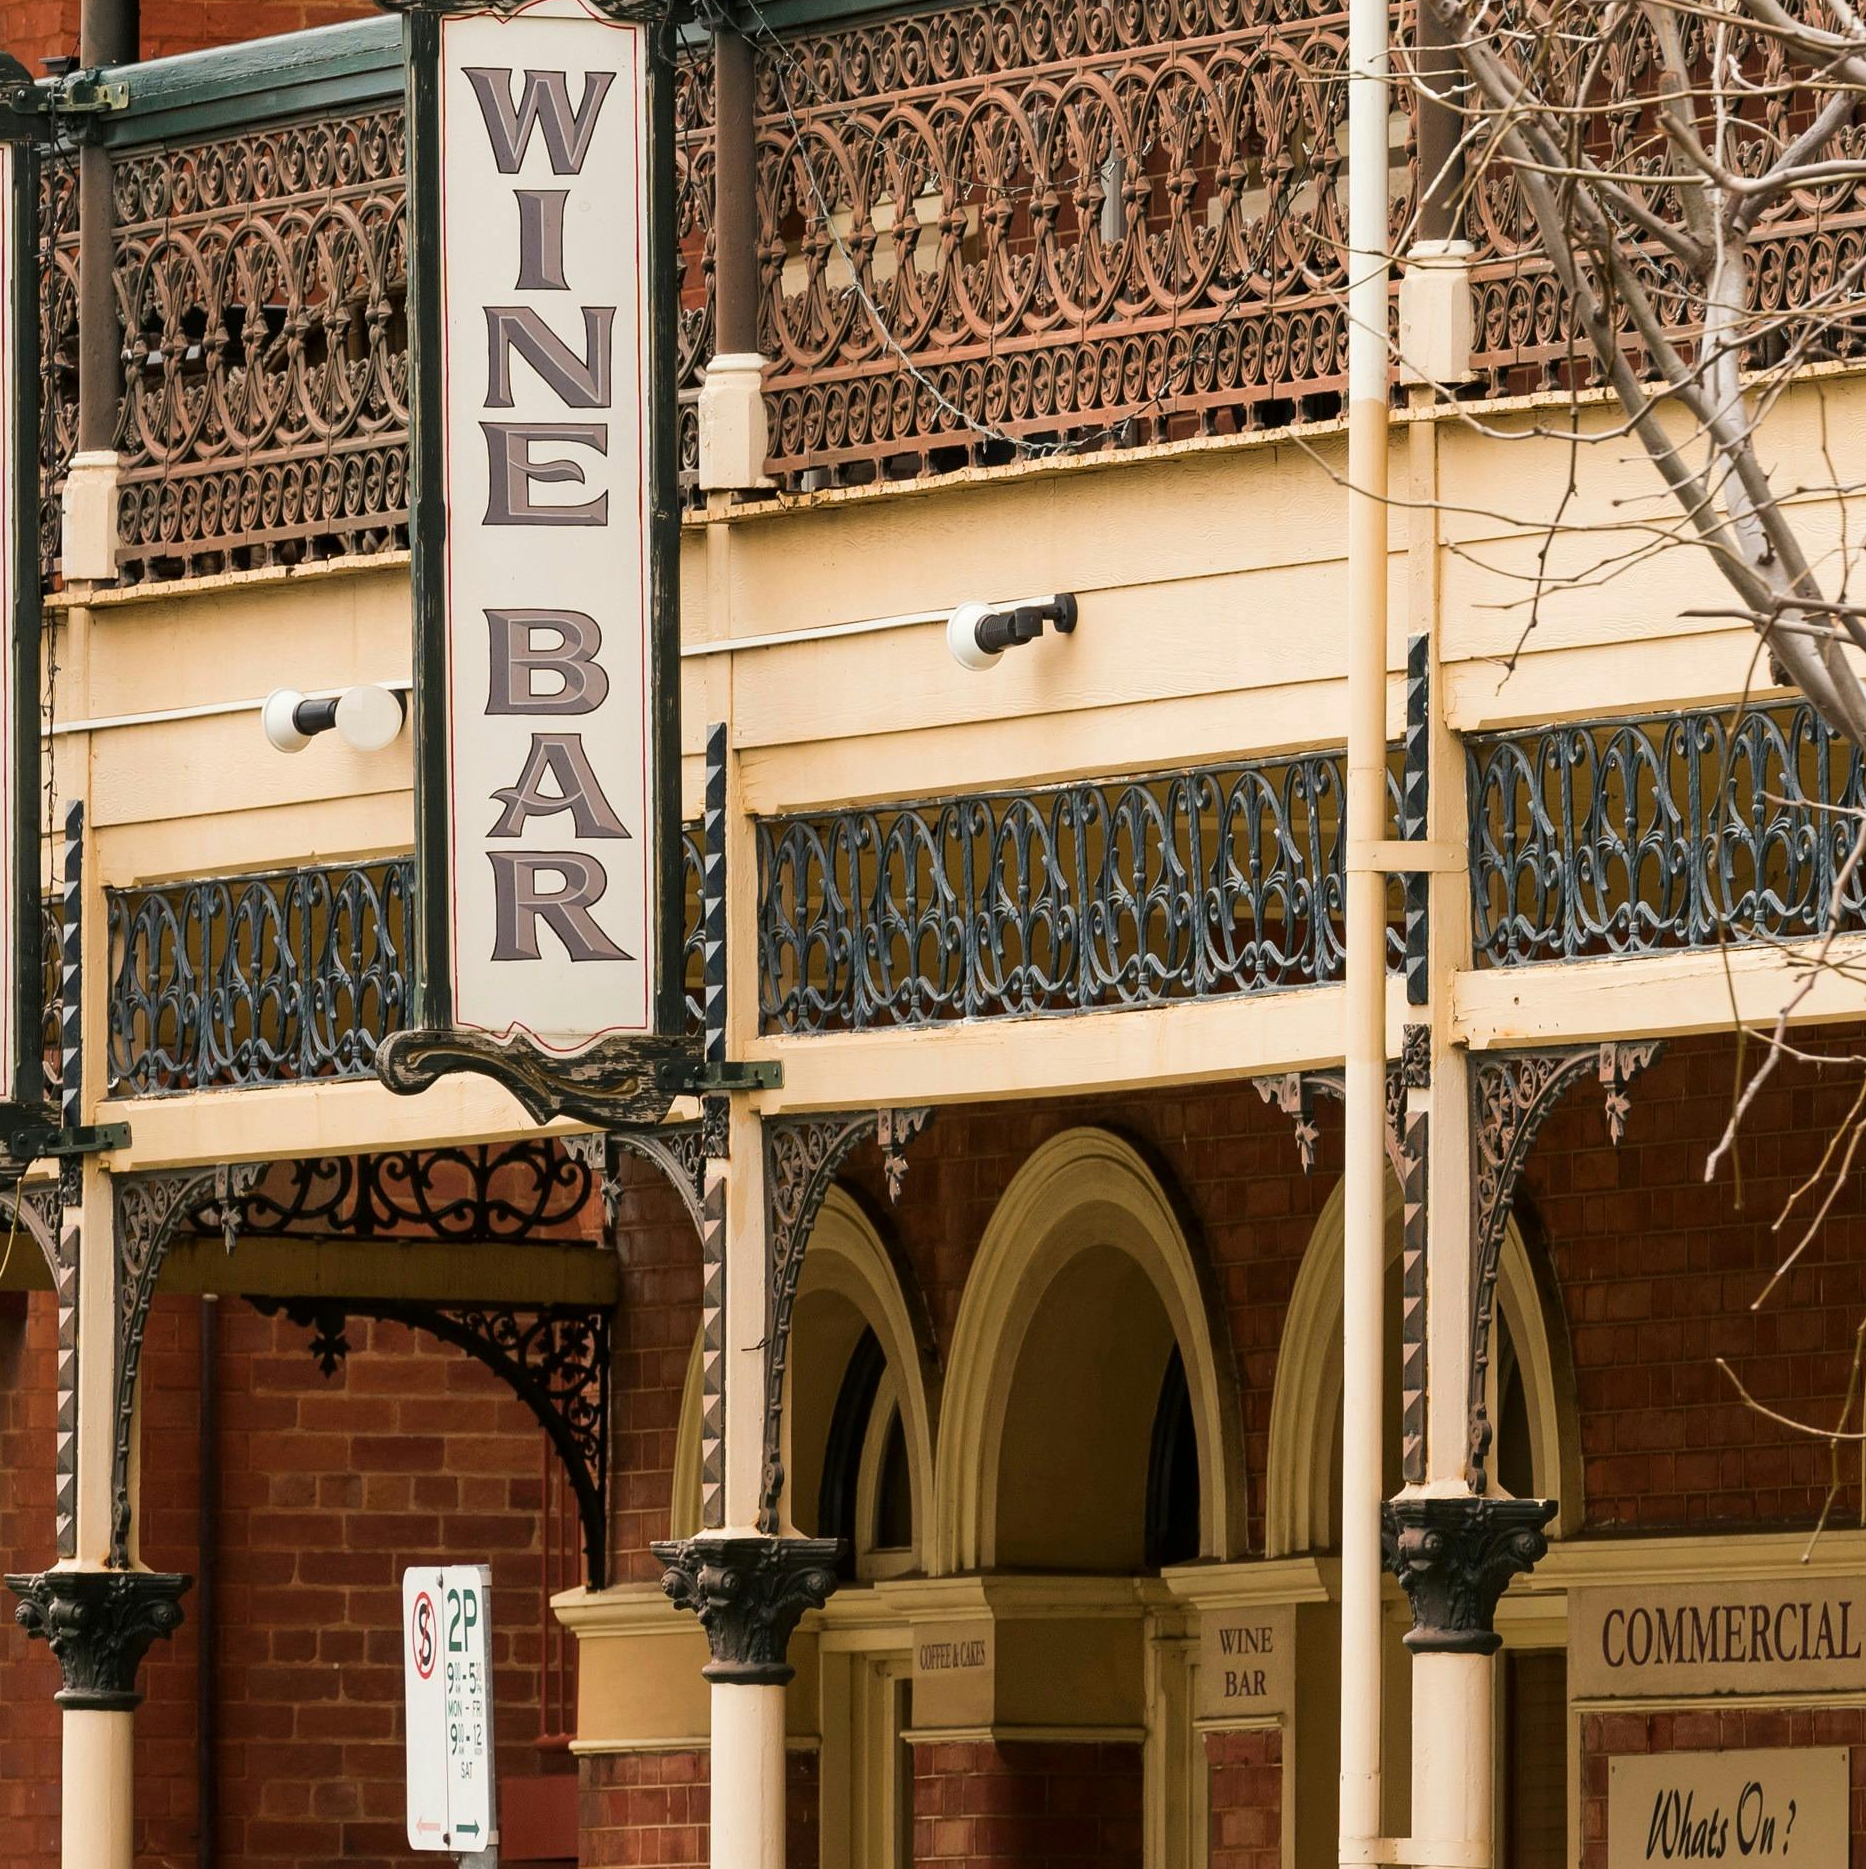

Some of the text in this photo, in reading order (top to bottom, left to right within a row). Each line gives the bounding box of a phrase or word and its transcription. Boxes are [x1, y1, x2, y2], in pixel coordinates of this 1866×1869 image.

[461, 67, 637, 962] WINE BAR
[447, 1588, 477, 1652] 2P
[1602, 1601, 1862, 1668] COMMERCIAL
[920, 1643, 951, 1670] COFFEE
[960, 1640, 985, 1667] CAKES
[1219, 1626, 1273, 1655] WINE
[1224, 1669, 1267, 1697] BAR
[448, 1700, 462, 1717] MON
[473, 1700, 482, 1717] FRI
[461, 1761, 472, 1779] SAT
[1646, 1789, 1728, 1860] Whats
[1737, 1781, 1775, 1856] On
